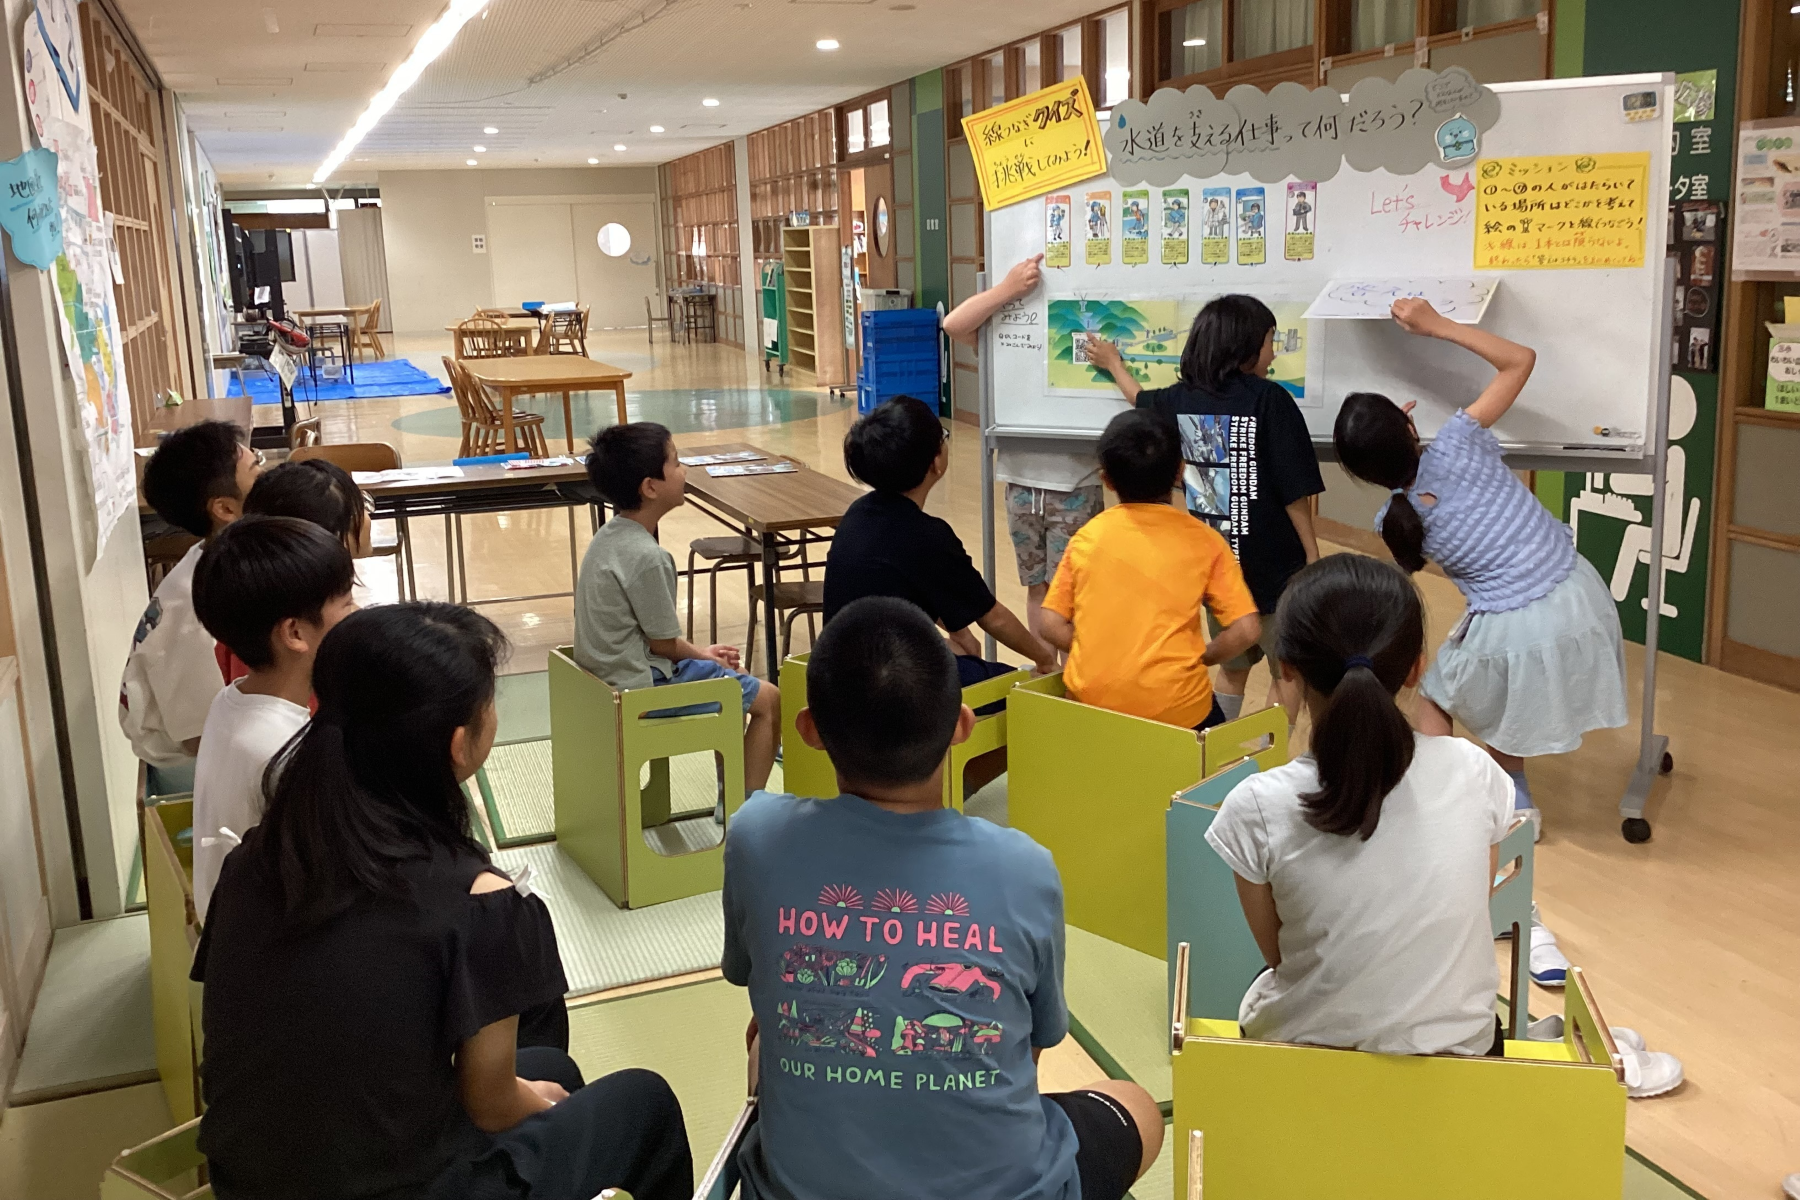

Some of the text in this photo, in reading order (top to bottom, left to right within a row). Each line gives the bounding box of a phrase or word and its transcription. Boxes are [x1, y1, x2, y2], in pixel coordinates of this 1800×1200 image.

[982, 88, 1083, 146] 線つなぎクイズ
[1119, 98, 1424, 156] 水道を支える仕事って何だろう?
[992, 139, 1091, 189] 挑戦してみよう!
[1024, 137, 1034, 147] に
[1371, 184, 1415, 215] Let's
[1229, 415, 1240, 449] STRIKE
[1229, 450, 1239, 494] FREEDOM
[1239, 416, 1249, 535] STRIKE FREEDOM GUNDAM
[1247, 416, 1258, 500] FREEDOM GUNDAM
[1230, 495, 1239, 536] GUNDAM
[778, 906, 1003, 953] HOW TO HEAL
[779, 1057, 1000, 1091] OUR HOME PLANET
